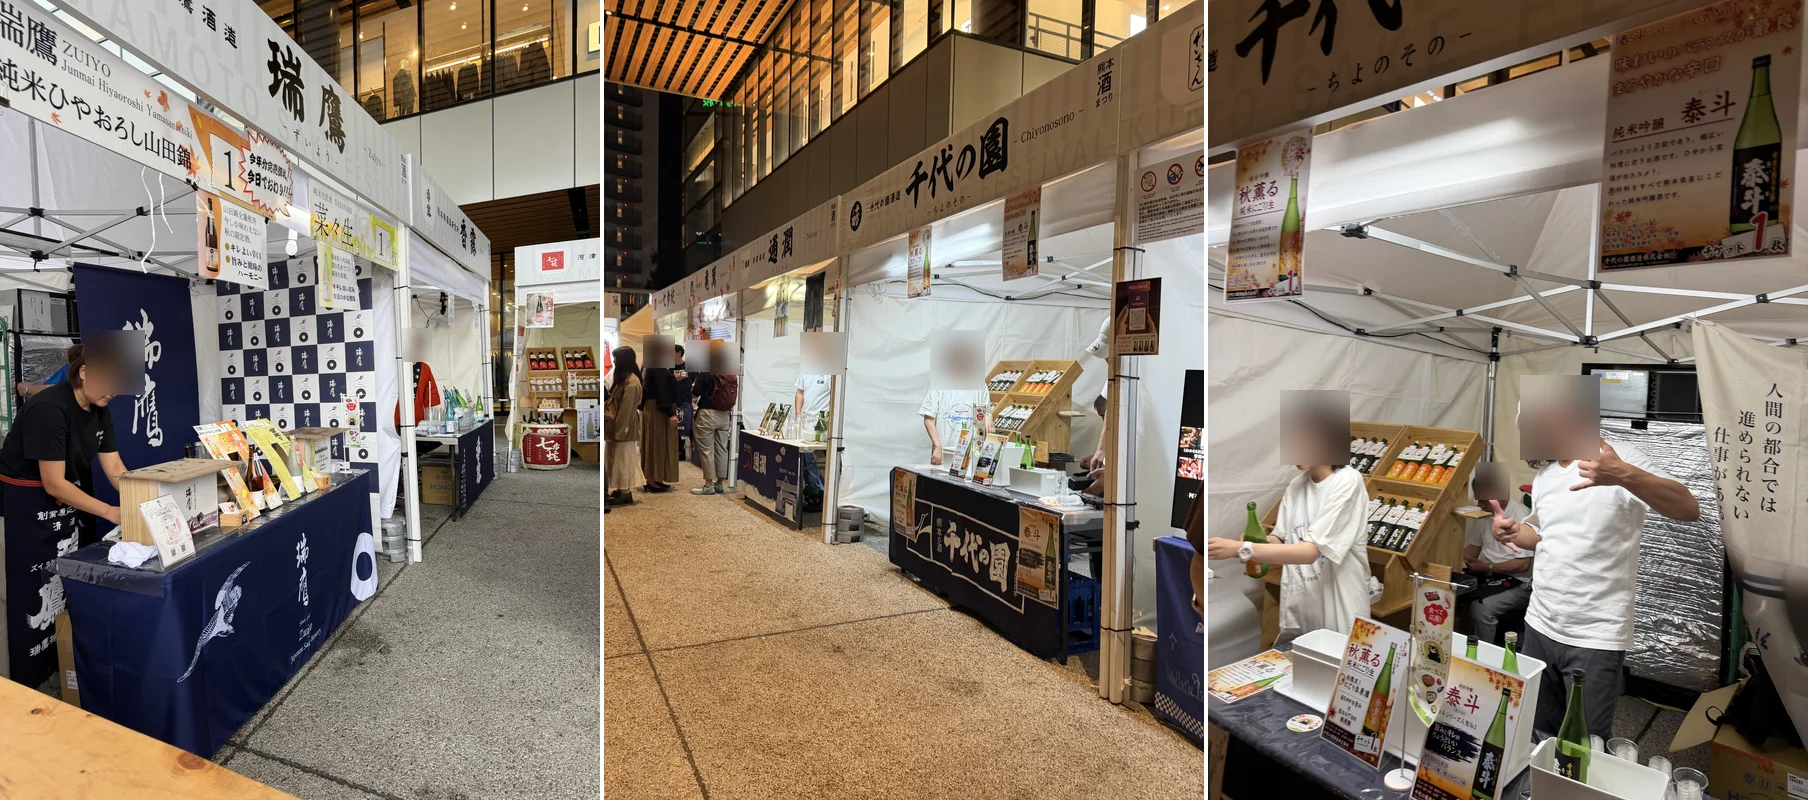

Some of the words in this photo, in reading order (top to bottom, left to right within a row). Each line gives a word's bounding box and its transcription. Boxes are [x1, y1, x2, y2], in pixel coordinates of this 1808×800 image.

[62, 39, 111, 78] ZUIYO
[1614, 12, 1794, 73] 味わいのバランスが最良
[61, 58, 96, 87] Junmai
[98, 76, 144, 112] Hiyaoroshi
[267, 38, 347, 154] 瑞鷹
[1097, 71, 1112, 96] 酒
[1611, 55, 1722, 97] まろやかな辛口
[0, 57, 192, 171] 純米ひやおろし山田錦
[1681, 90, 1737, 123] 泰斗
[1021, 112, 1074, 144] Chiyonosono
[1613, 117, 1665, 139] 純米吟醸
[224, 151, 236, 191] 1
[905, 115, 1009, 209] 千代の園
[1239, 180, 1279, 204] 秋薫る
[1701, 242, 1746, 259] チケット
[1750, 211, 1768, 252] 1
[238, 271, 262, 280] ハーモニー
[535, 437, 561, 463] 七歩蛇
[1733, 409, 1756, 520] 進められない
[1761, 382, 1784, 513] 人間の都合では
[1023, 524, 1041, 541] 泰斗
[943, 519, 1011, 593] 千代の園
[1347, 642, 1381, 668] 秋薫る
[1445, 686, 1480, 715] 泰斗
[1479, 750, 1496, 790] 泰斗
